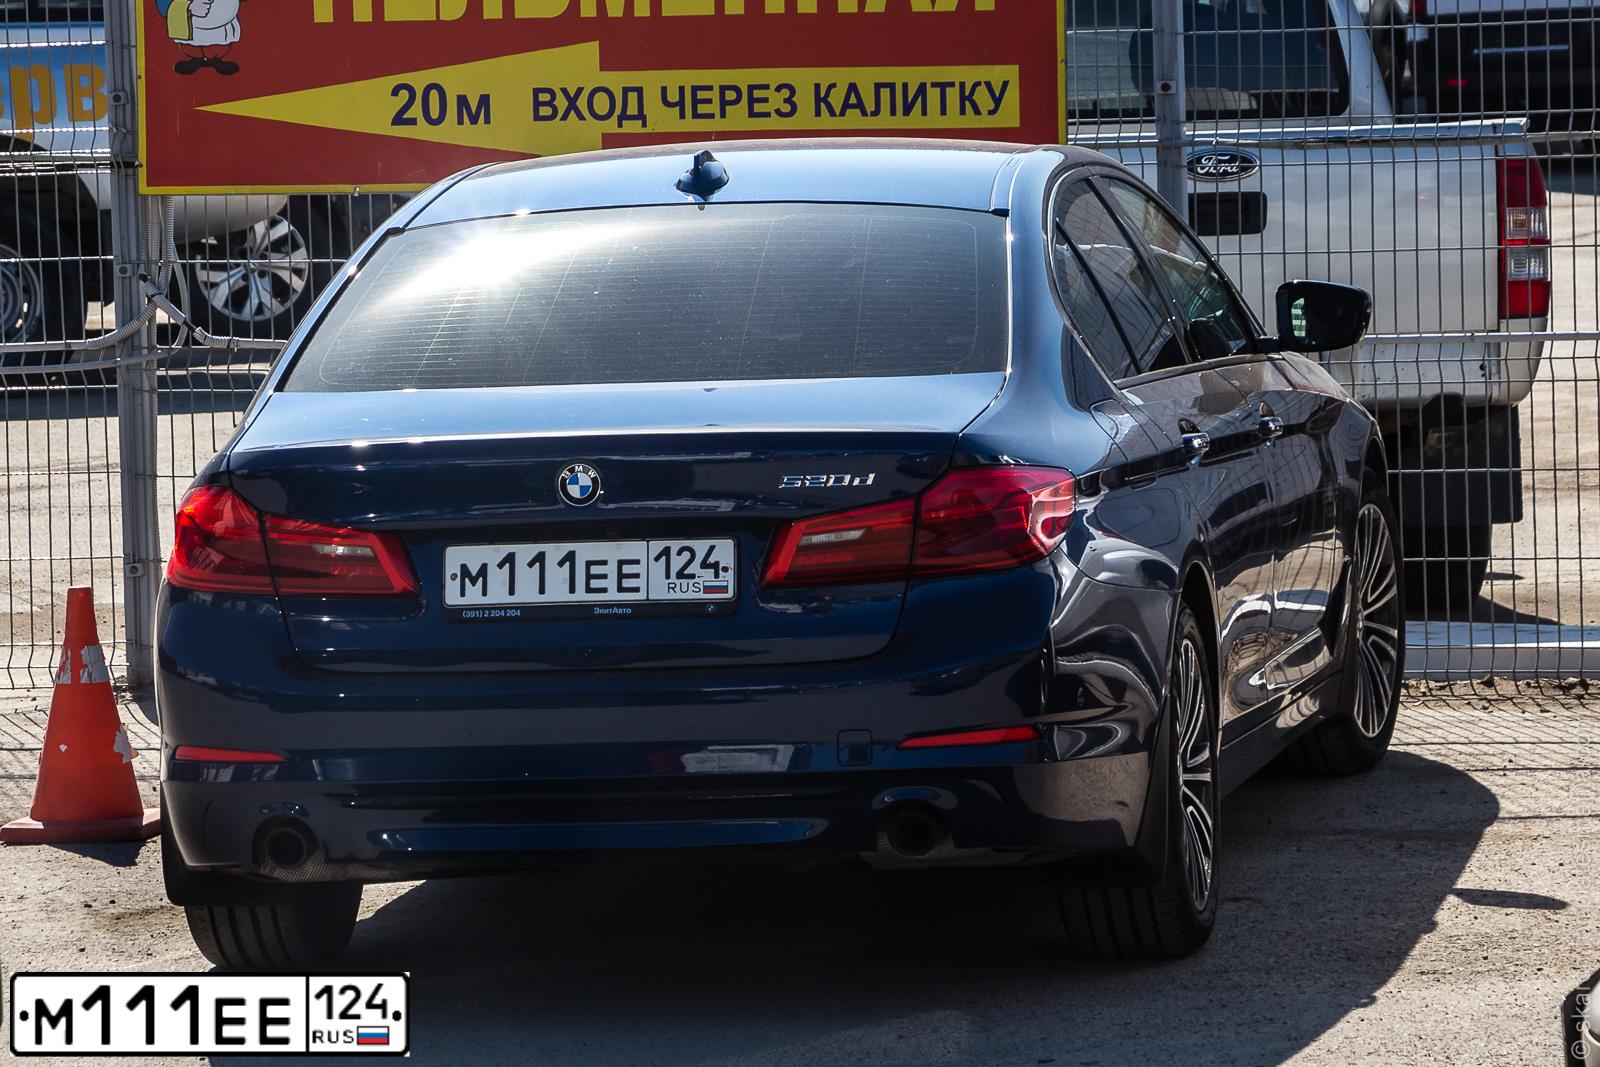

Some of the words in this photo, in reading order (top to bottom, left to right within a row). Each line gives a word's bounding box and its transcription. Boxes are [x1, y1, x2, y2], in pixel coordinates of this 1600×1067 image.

[532, 86, 648, 128] ВХОД
[660, 83, 798, 120] ЧЕРЕЗ
[813, 80, 1010, 117] КАЛИТКУ
[1197, 155, 1239, 174] Ford
[779, 473, 875, 488] 520d
[653, 545, 720, 580] 124
[667, 581, 701, 594] RUS
[462, 610, 483, 618] (391)
